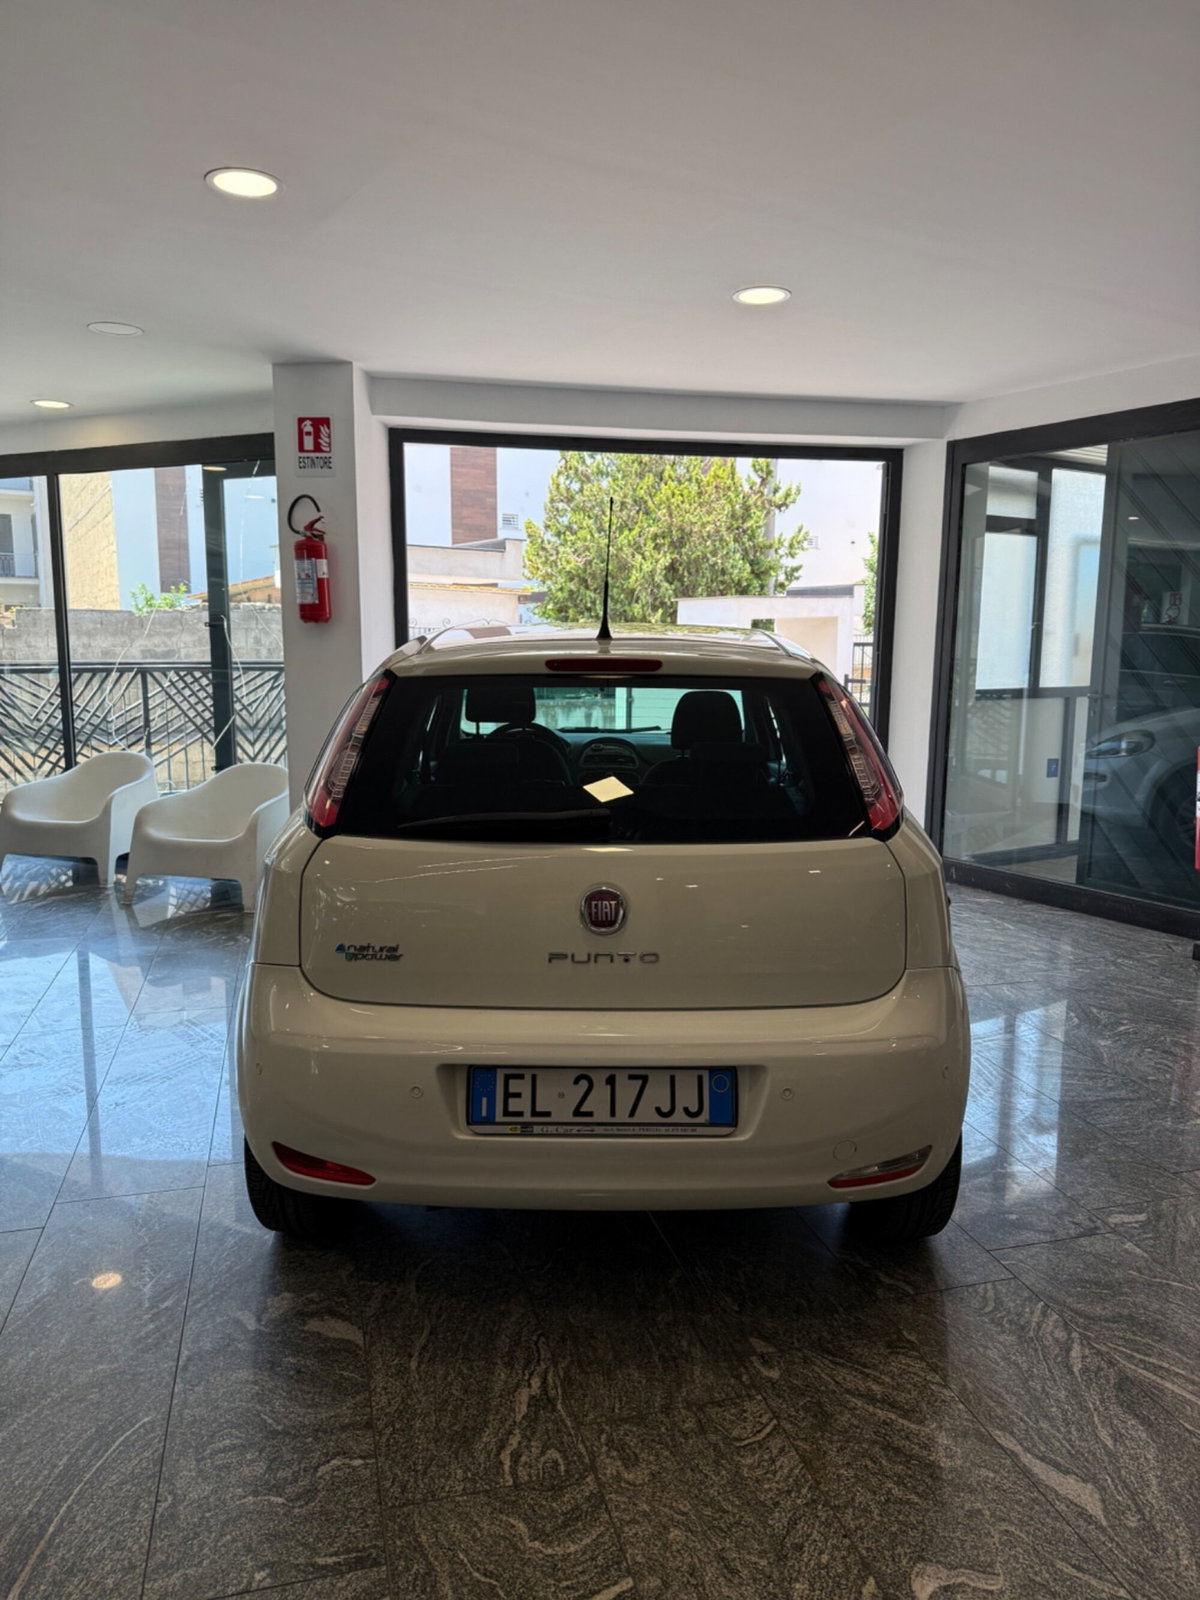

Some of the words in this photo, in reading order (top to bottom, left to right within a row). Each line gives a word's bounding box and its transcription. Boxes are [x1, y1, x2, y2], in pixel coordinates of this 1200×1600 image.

[298, 456, 332, 469] ESTINTORE
[591, 901, 616, 921] FIAT
[346, 943, 400, 953] natural
[352, 952, 404, 962] power
[548, 953, 660, 964] PUNTO
[502, 1074, 552, 1118] EL
